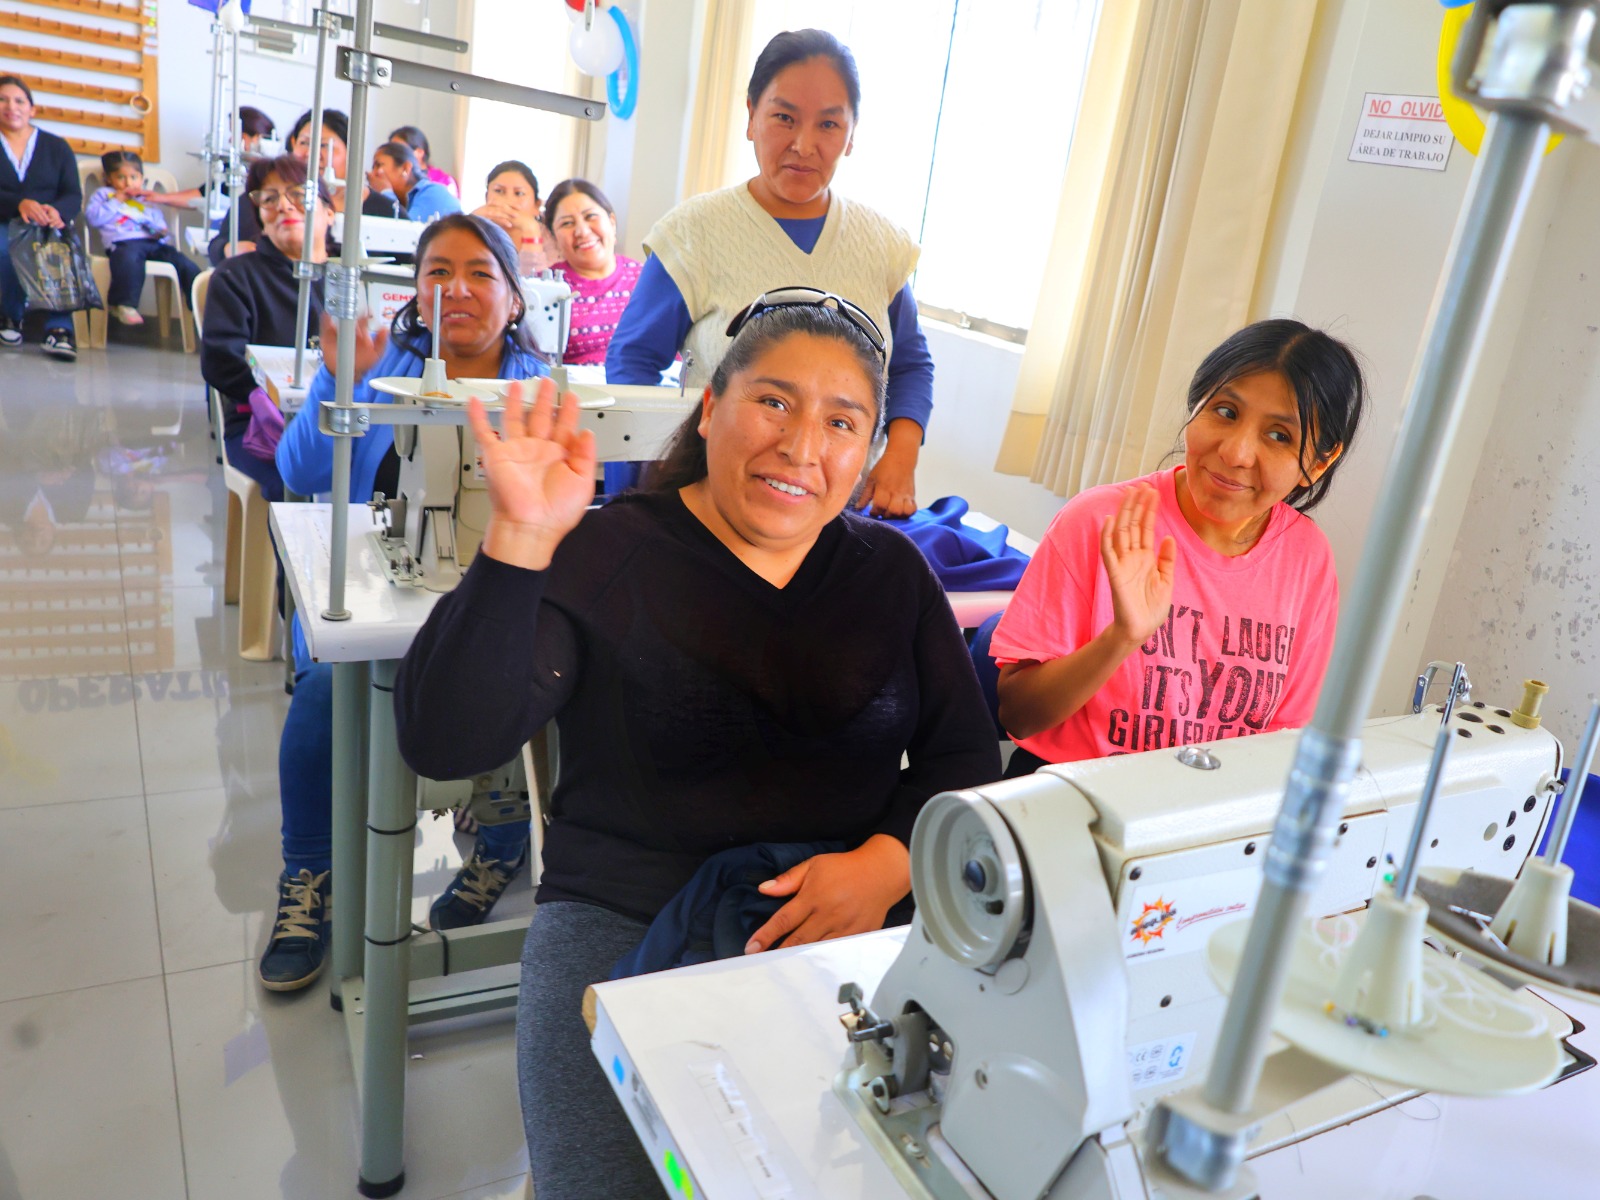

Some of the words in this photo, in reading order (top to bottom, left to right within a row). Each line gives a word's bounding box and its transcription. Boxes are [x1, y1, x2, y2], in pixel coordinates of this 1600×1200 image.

[1369, 99, 1392, 115] NO
[1400, 101, 1444, 119] OLVID
[1363, 128, 1392, 141] DEJAR
[1394, 131, 1431, 144] LIMPIO
[1432, 135, 1447, 145] SU
[1382, 147, 1397, 158] DE
[1398, 149, 1444, 163] TRABAJO
[1140, 604, 1204, 664] N'T
[1141, 664, 1193, 717] IT'S
[1107, 708, 1257, 752] GIRLFRI
